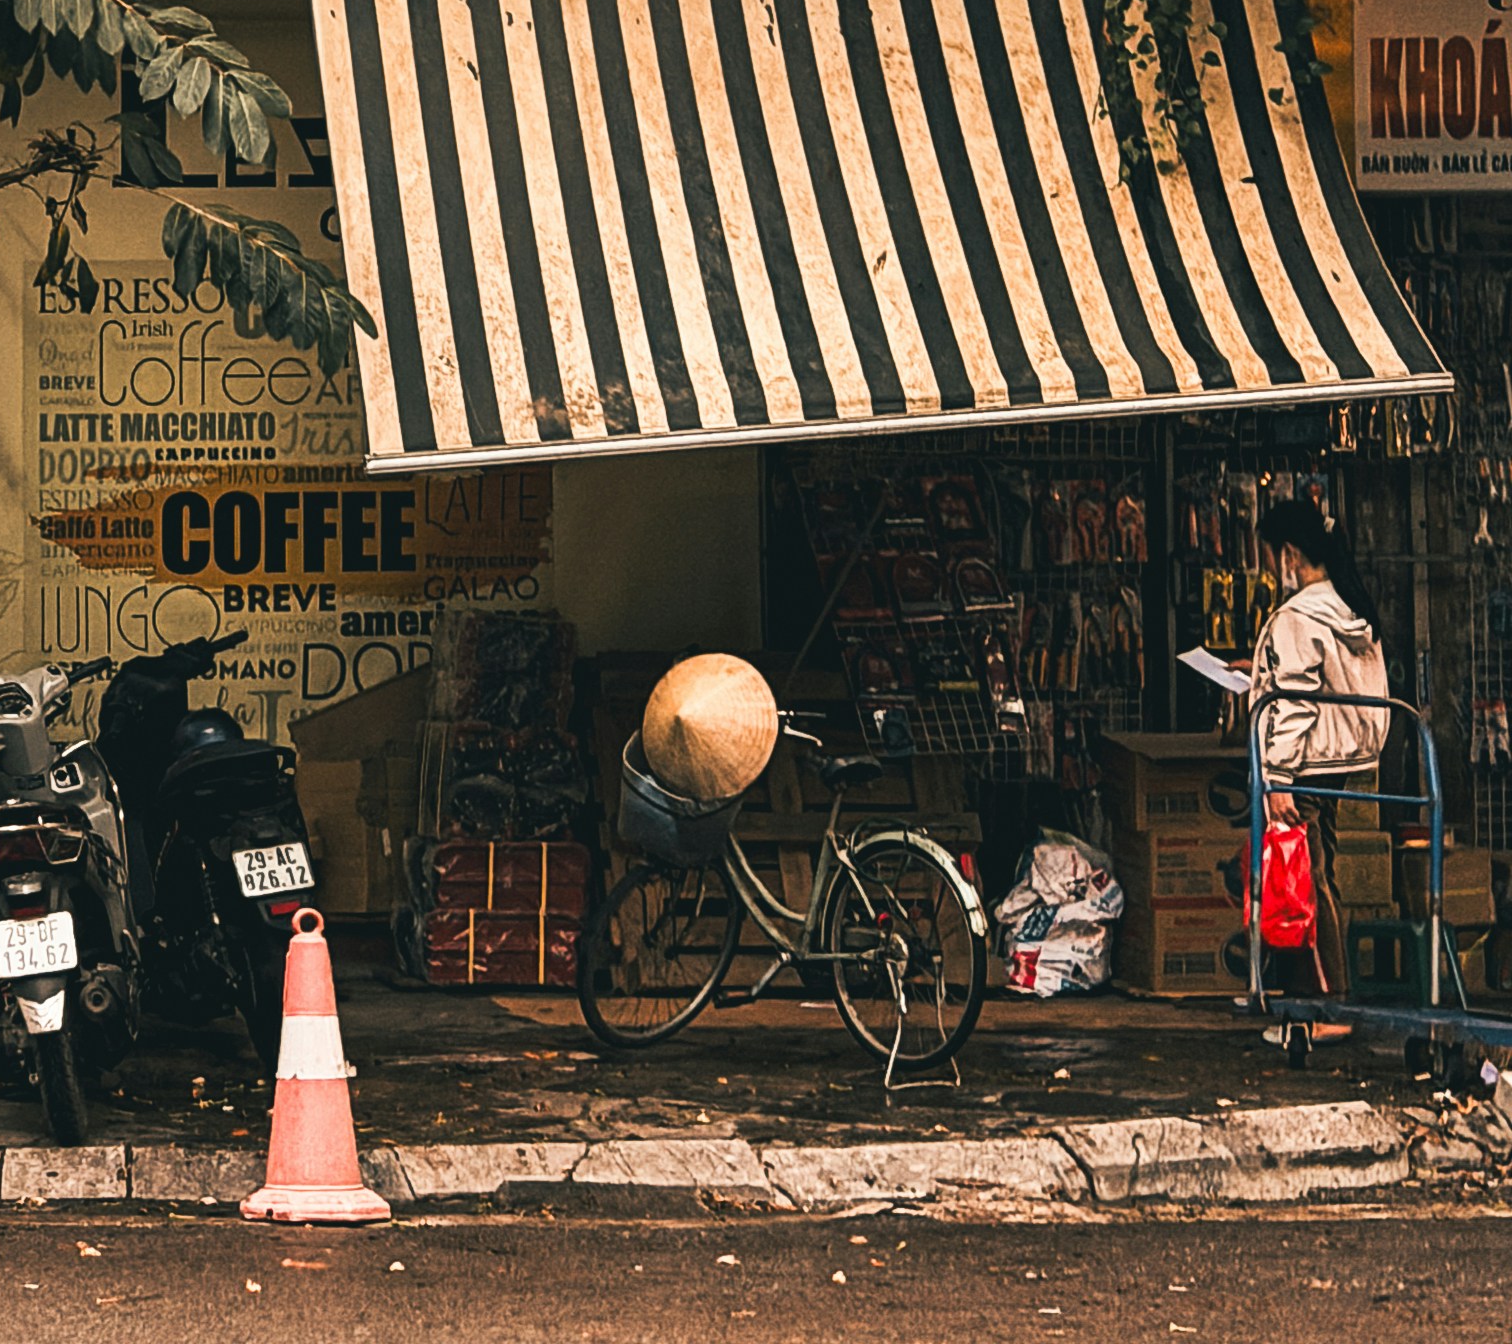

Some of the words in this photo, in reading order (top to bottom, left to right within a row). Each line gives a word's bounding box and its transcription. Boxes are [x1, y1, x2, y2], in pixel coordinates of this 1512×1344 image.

[132, 319, 173, 337] Irish
[100, 319, 312, 407] Coffee
[39, 375, 95, 391] BREVE
[39, 413, 114, 442] LATTE
[120, 411, 276, 442] MACCHIATO
[155, 446, 276, 461] CAPPUCCINO
[155, 464, 280, 485] MACCHIATO
[162, 490, 416, 575] COFFEE
[223, 583, 337, 613] BREVE
[41, 584, 222, 654] LUNGO
[3, 942, 70, 974] 134.62
